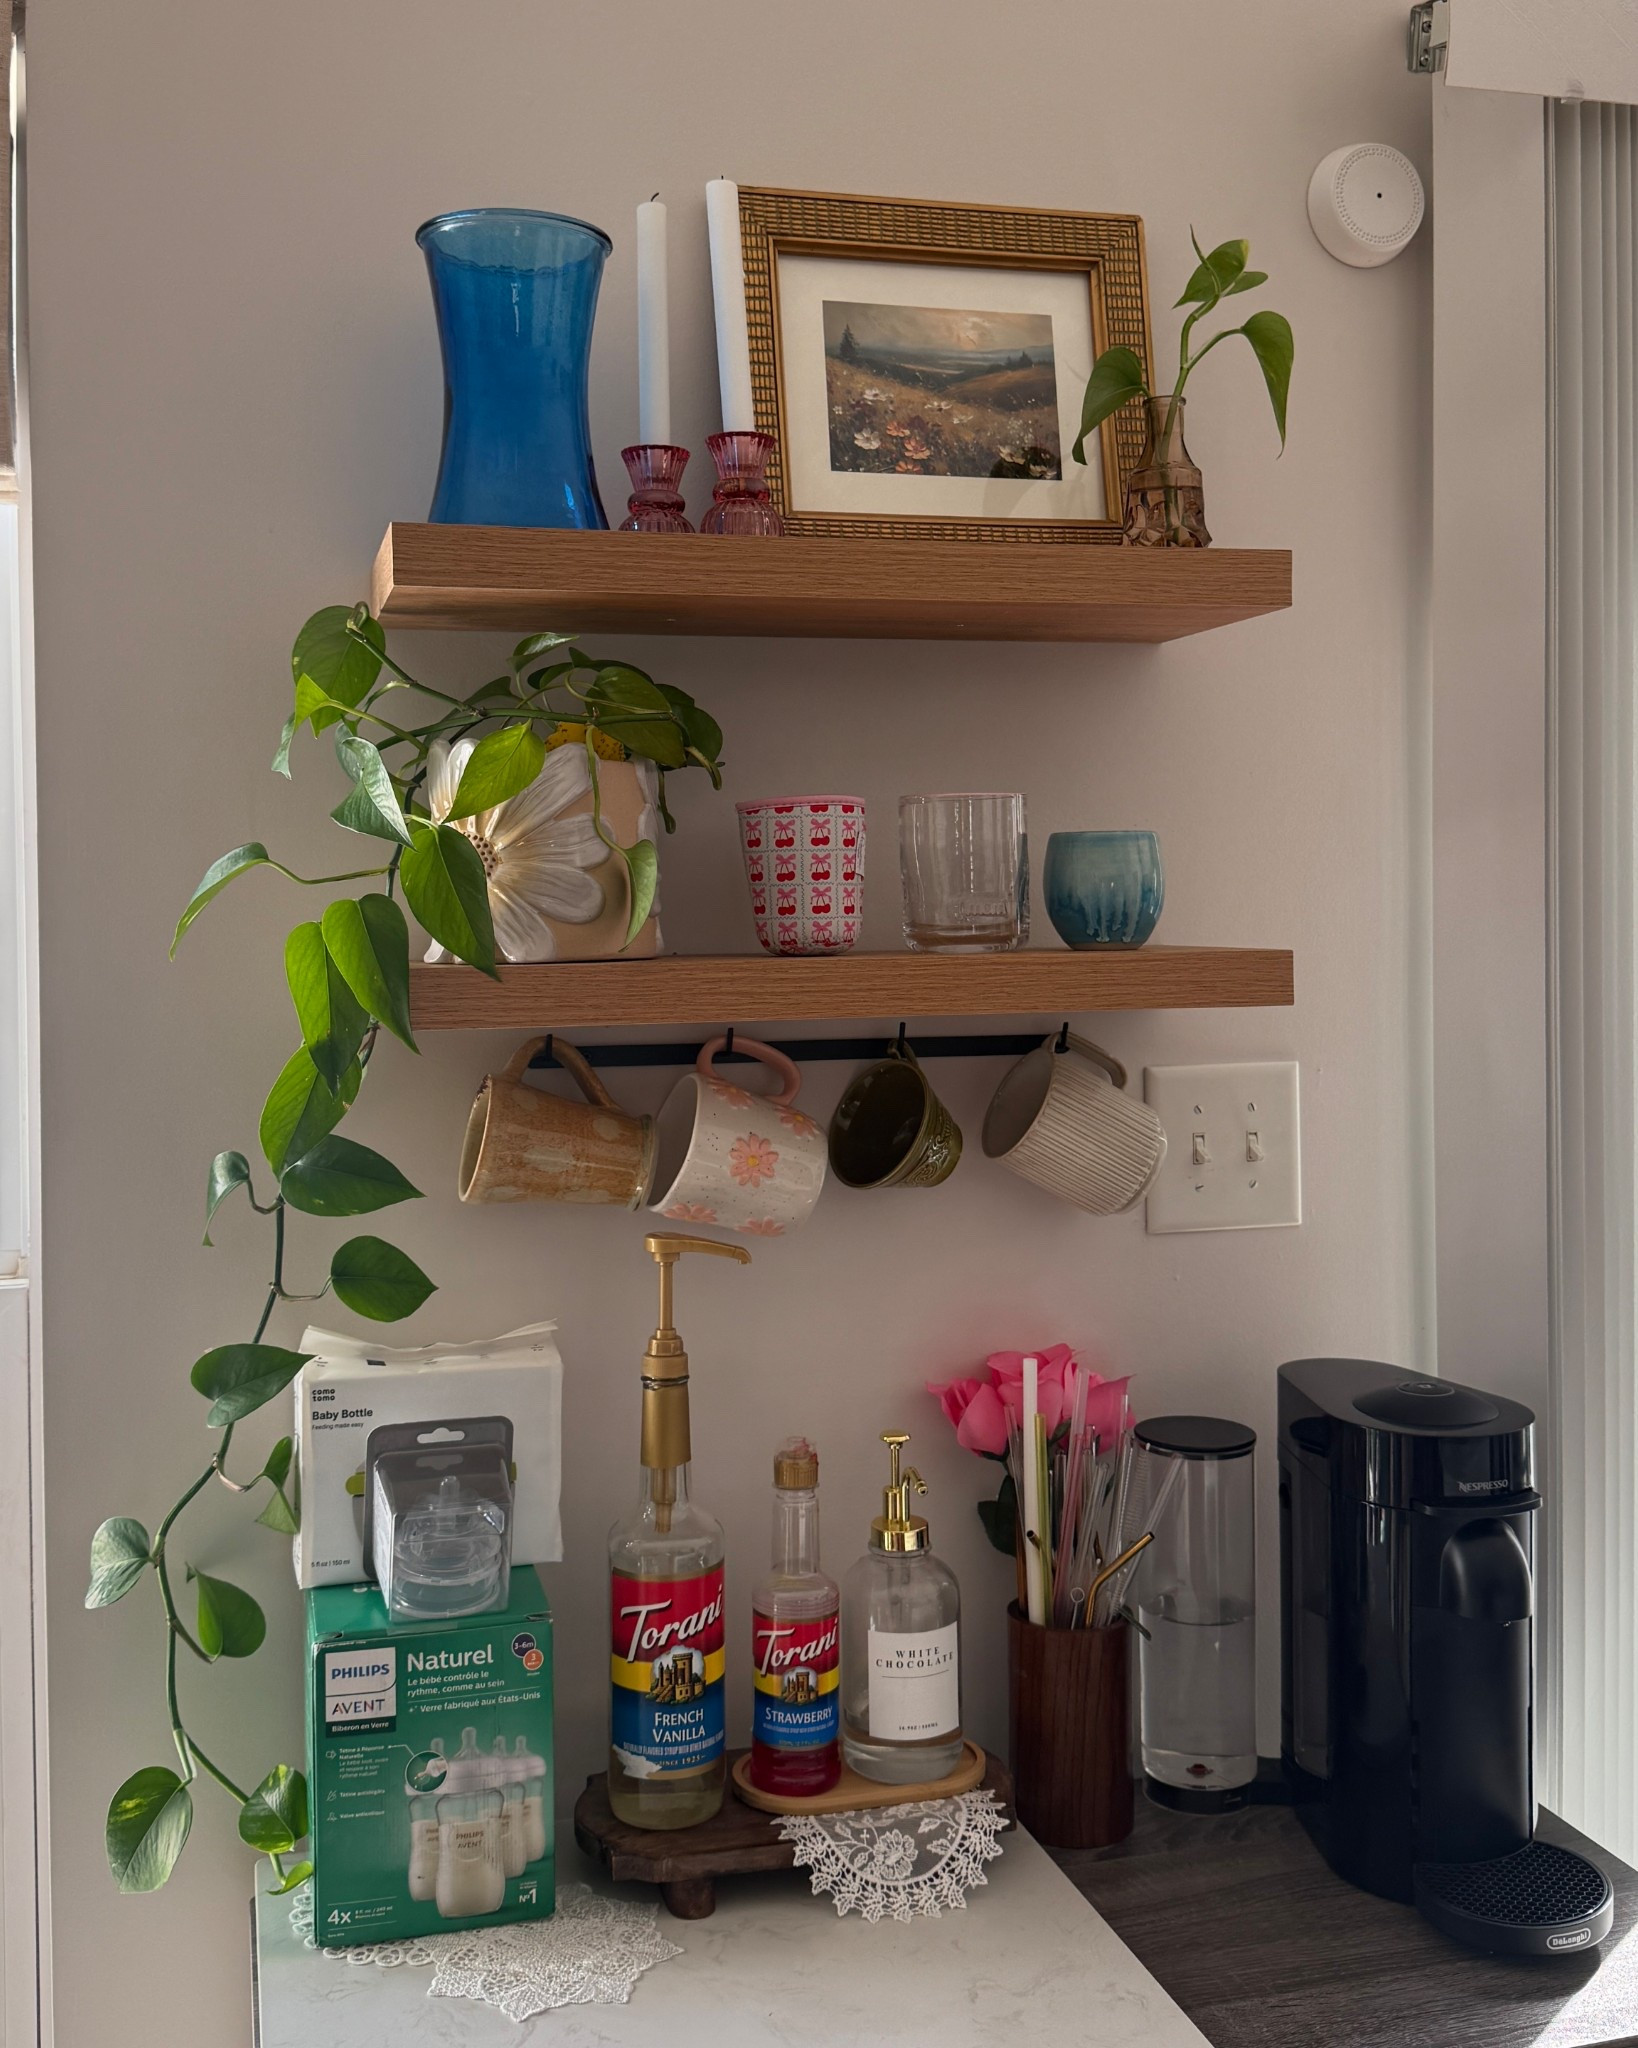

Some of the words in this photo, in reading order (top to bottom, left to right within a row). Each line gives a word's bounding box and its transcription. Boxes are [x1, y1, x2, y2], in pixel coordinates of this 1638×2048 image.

[312, 1388, 335, 1396] como
[312, 1394, 335, 1402] tomo
[312, 1410, 339, 1421] Baby
[341, 1408, 373, 1419] Bottle
[1457, 1479, 1508, 1493] NESPRESSO
[620, 1584, 723, 1664] Torani
[514, 1641, 534, 1650] 3-6m
[757, 1618, 838, 1678] Torani
[895, 1646, 940, 1659] WHITE
[407, 1644, 494, 1673] Naturel
[875, 1652, 954, 1669] CHOCOLATE
[331, 1663, 390, 1680] PHILIPS
[408, 1678, 418, 1686] Le
[419, 1674, 442, 1685] bébé
[443, 1671, 479, 1683] contrôle
[480, 1670, 489, 1679] le
[407, 1686, 441, 1698] rythme,
[442, 1682, 473, 1693] comme
[487, 1679, 505, 1688] sein
[332, 1698, 386, 1716] AVENT
[420, 1703, 442, 1713] Verre
[443, 1699, 480, 1711] fabriqué
[481, 1698, 496, 1706] aux
[497, 1691, 541, 1704] États-Unis
[654, 1708, 704, 1727] FRENCH
[765, 1706, 833, 1724] STRAWBERRY
[332, 1723, 360, 1733] Biberon
[371, 1721, 390, 1729] Verre
[652, 1726, 706, 1744] VANILLA
[455, 1830, 485, 1840] PHILIPS
[457, 1839, 483, 1849] AVENT
[327, 1908, 352, 1925] 4x
[1552, 1931, 1588, 1946] DeLonghi
